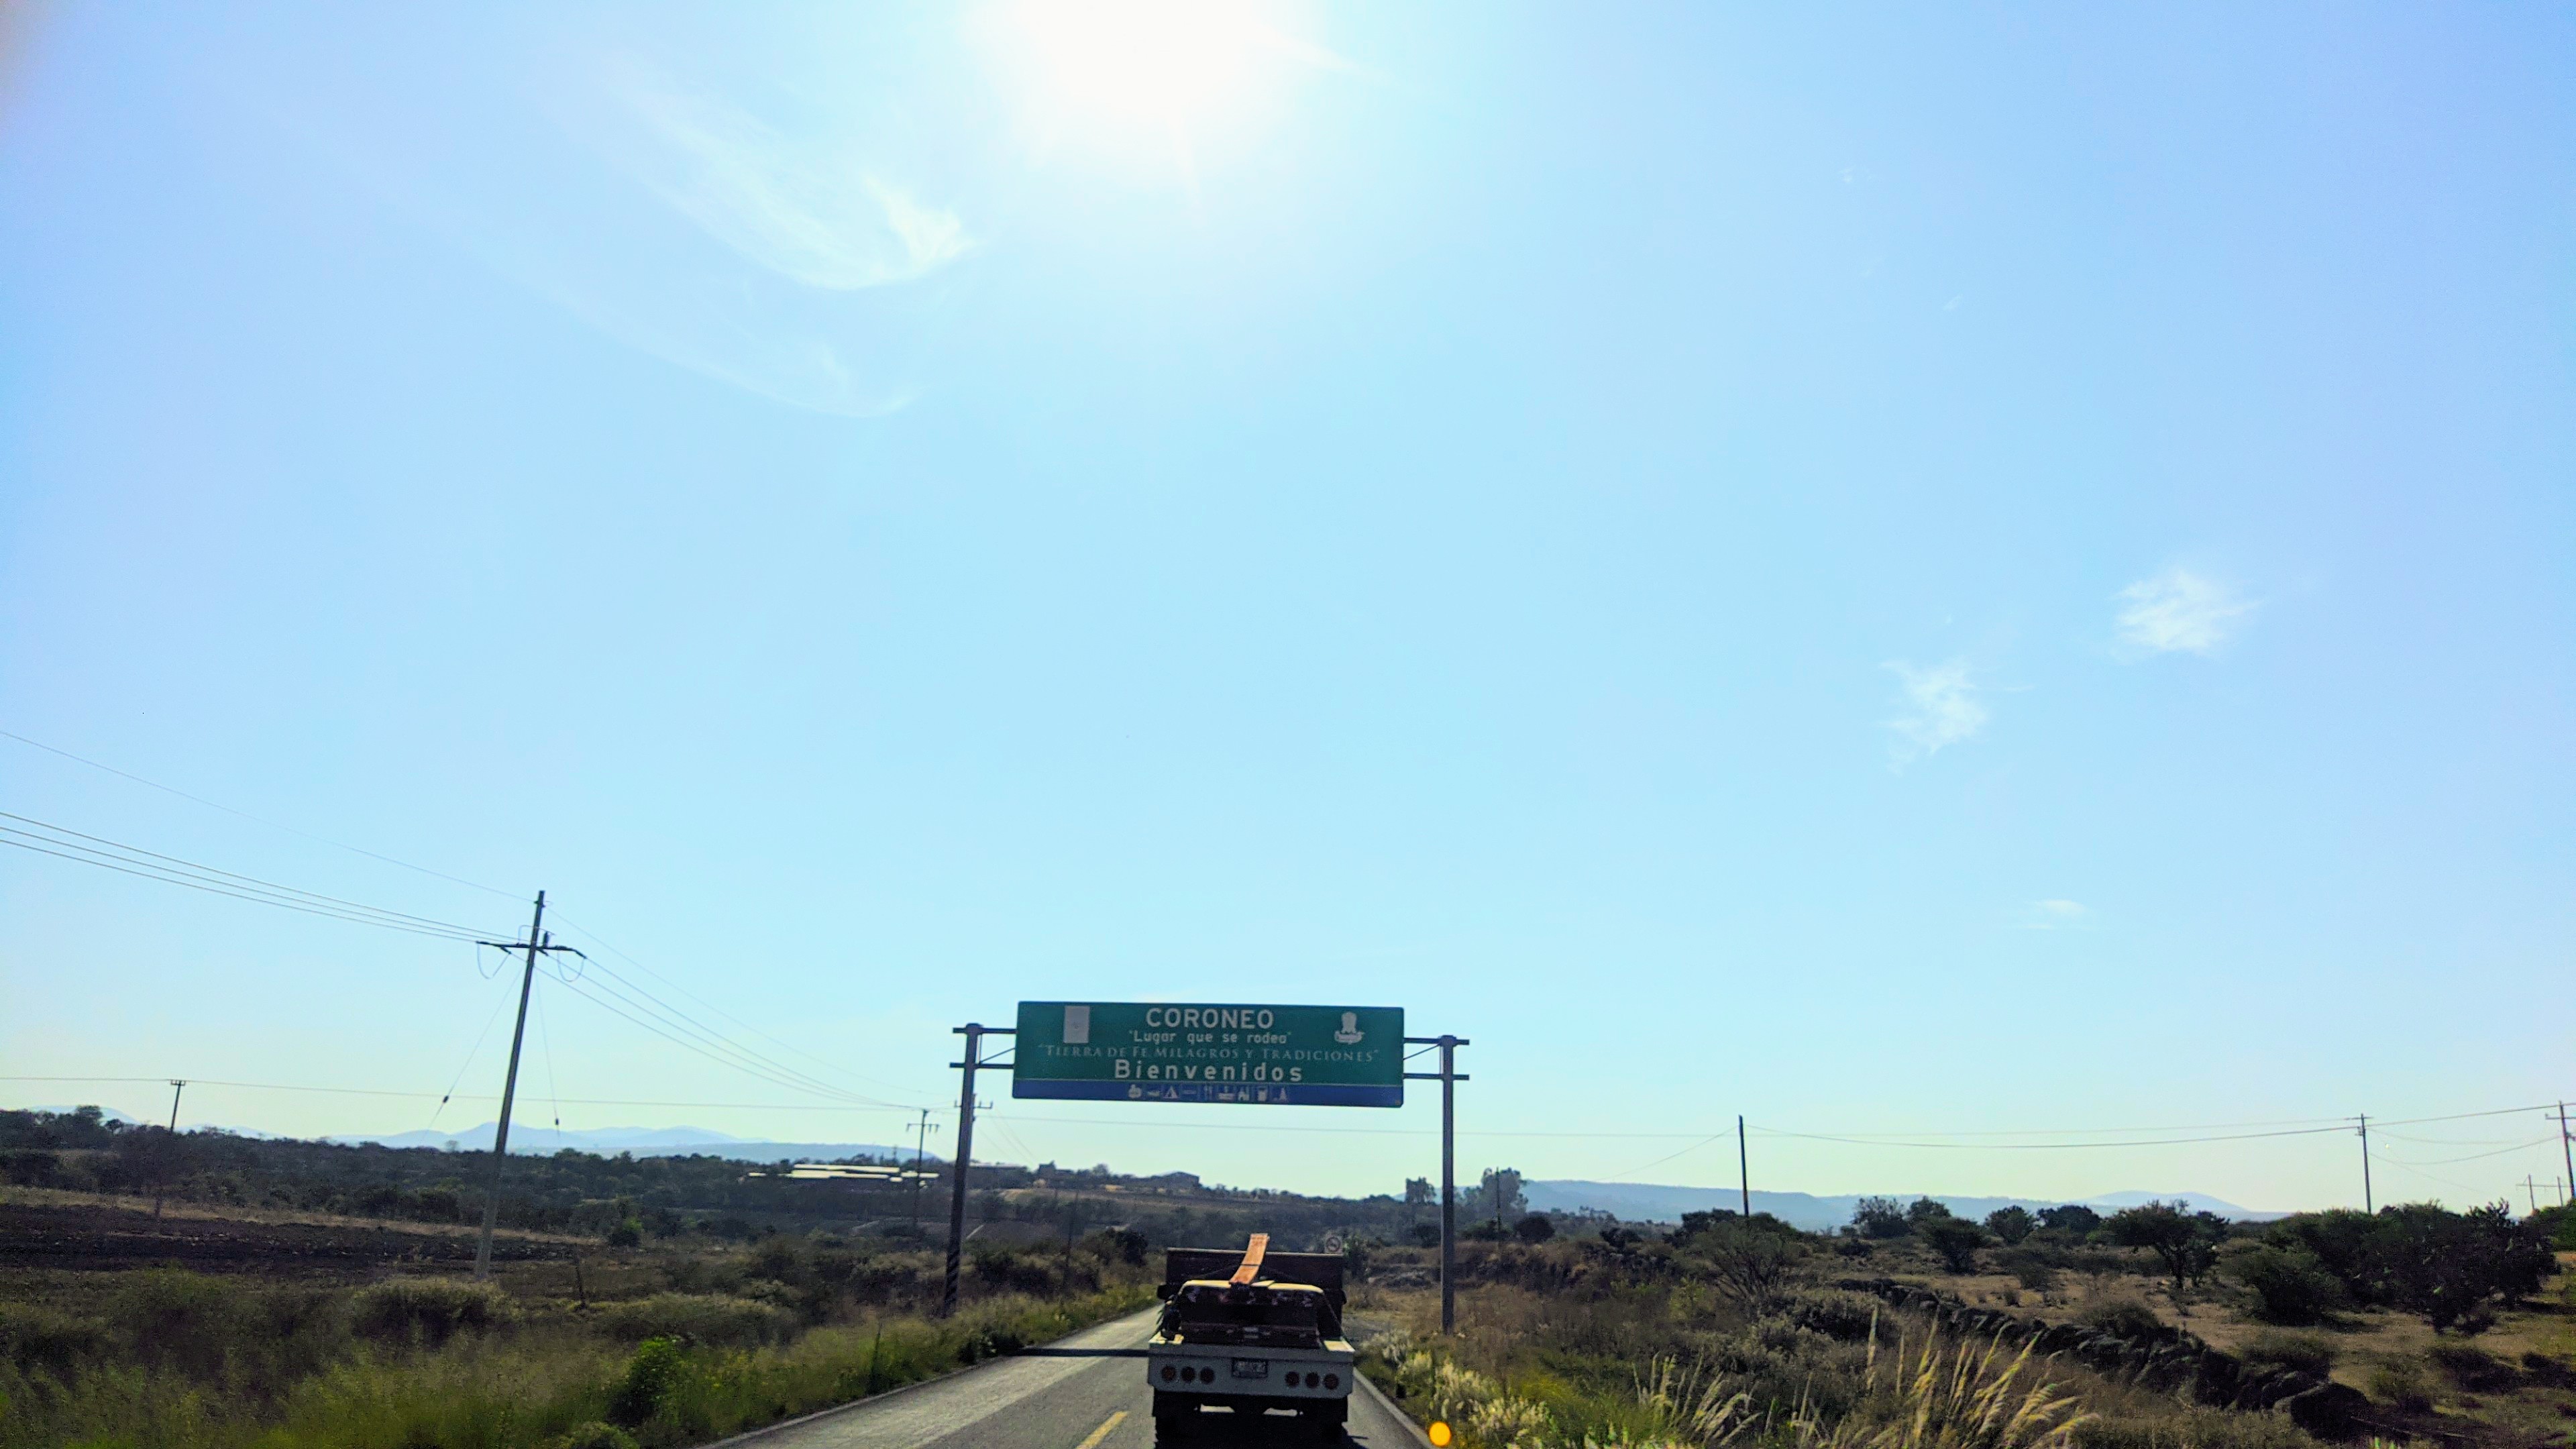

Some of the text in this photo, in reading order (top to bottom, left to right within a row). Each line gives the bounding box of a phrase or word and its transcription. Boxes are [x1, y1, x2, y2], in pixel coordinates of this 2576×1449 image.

[1146, 1008, 1274, 1029] CORONEO
[1187, 1033, 1214, 1044] que
[1222, 1033, 1237, 1043] se
[1108, 1046, 1125, 1057] DE
[1155, 1047, 1238, 1059] MILAGROS
[1245, 1049, 1256, 1059] Y
[1115, 1059, 1303, 1082] Bienvenidos
